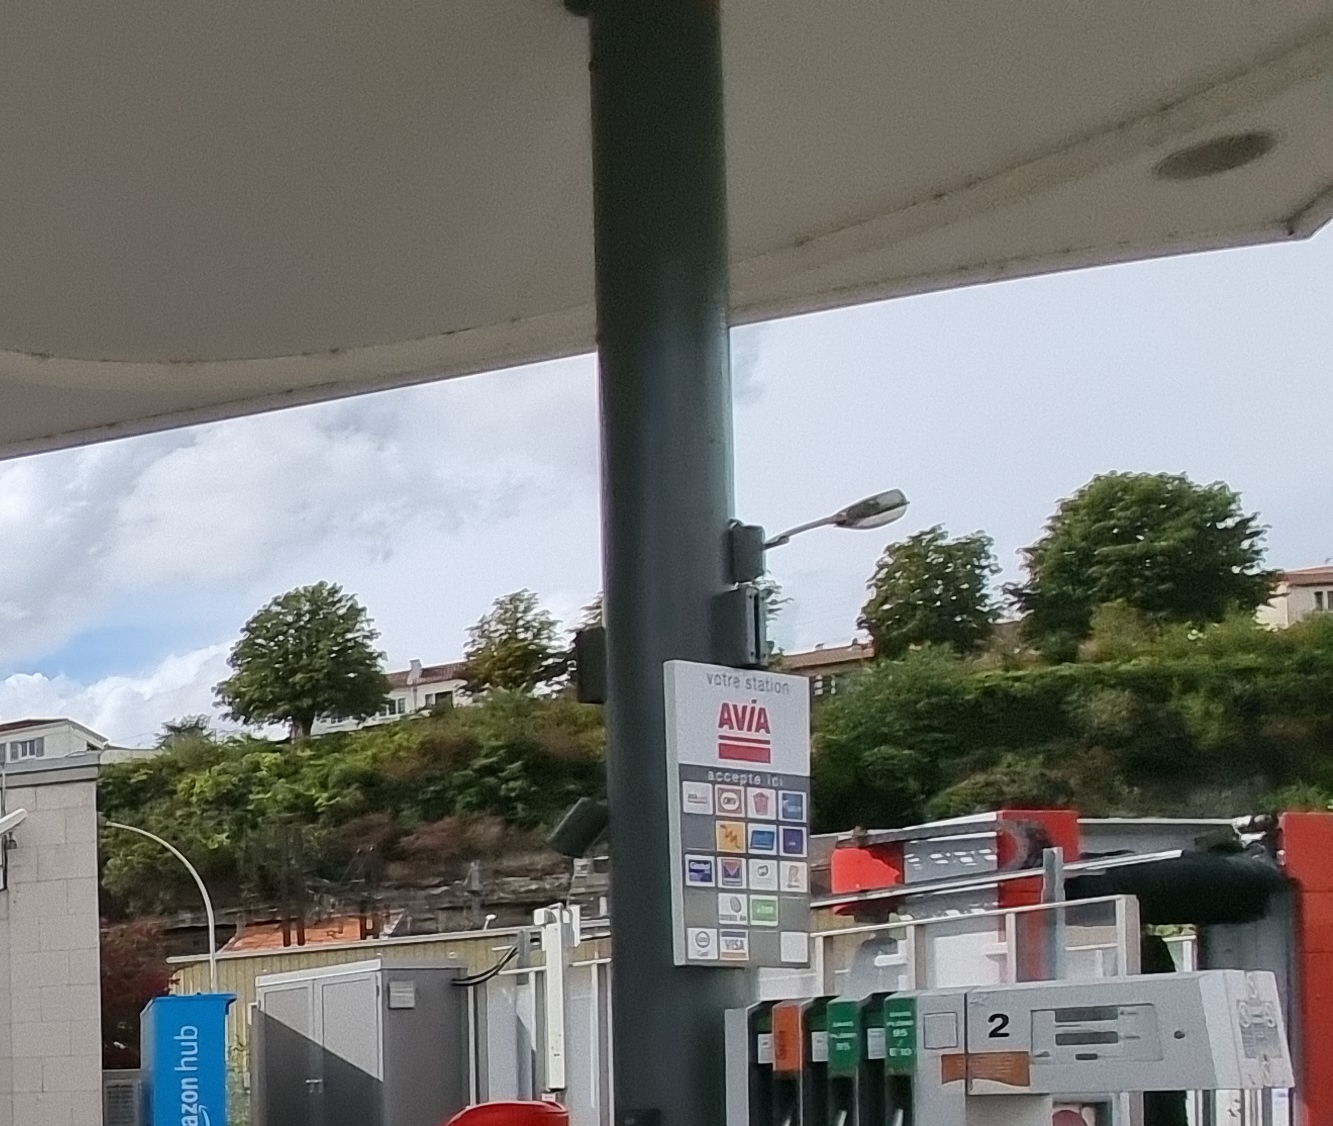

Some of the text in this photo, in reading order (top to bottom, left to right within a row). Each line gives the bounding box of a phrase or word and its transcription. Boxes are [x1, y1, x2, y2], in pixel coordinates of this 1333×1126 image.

[706, 672, 790, 695] votre station
[718, 699, 771, 734] AVIA
[707, 771, 784, 787] accepte ici
[987, 1013, 1010, 1038] 2
[174, 1025, 198, 1071] hub
